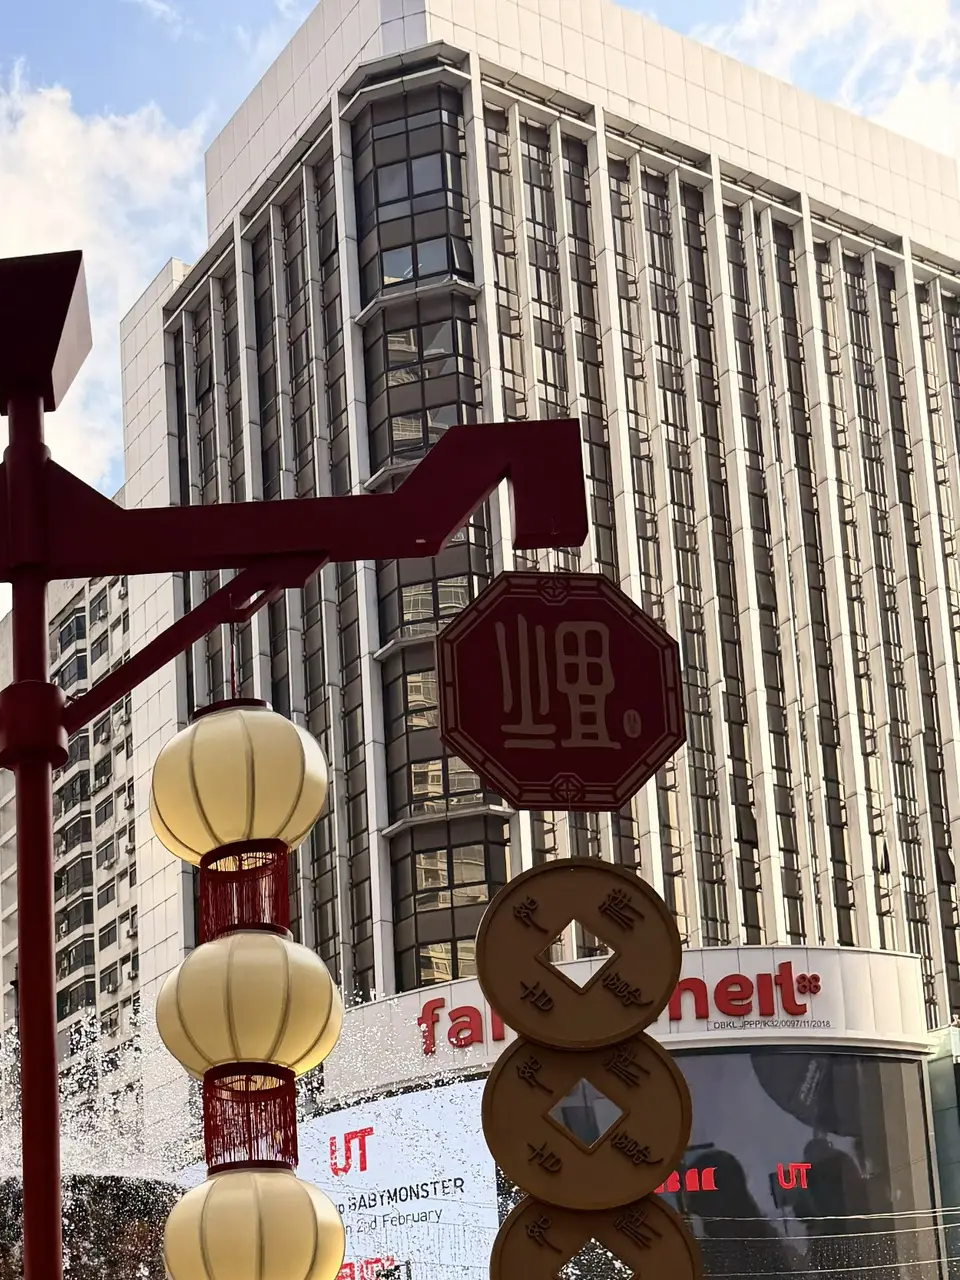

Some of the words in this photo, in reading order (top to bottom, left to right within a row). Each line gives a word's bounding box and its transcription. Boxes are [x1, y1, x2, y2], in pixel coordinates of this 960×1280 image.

[329, 1126, 374, 1176] UT
[776, 1163, 812, 1189] UT
[348, 1177, 465, 1213] BABYMONSTER
[382, 1209, 443, 1229] February
